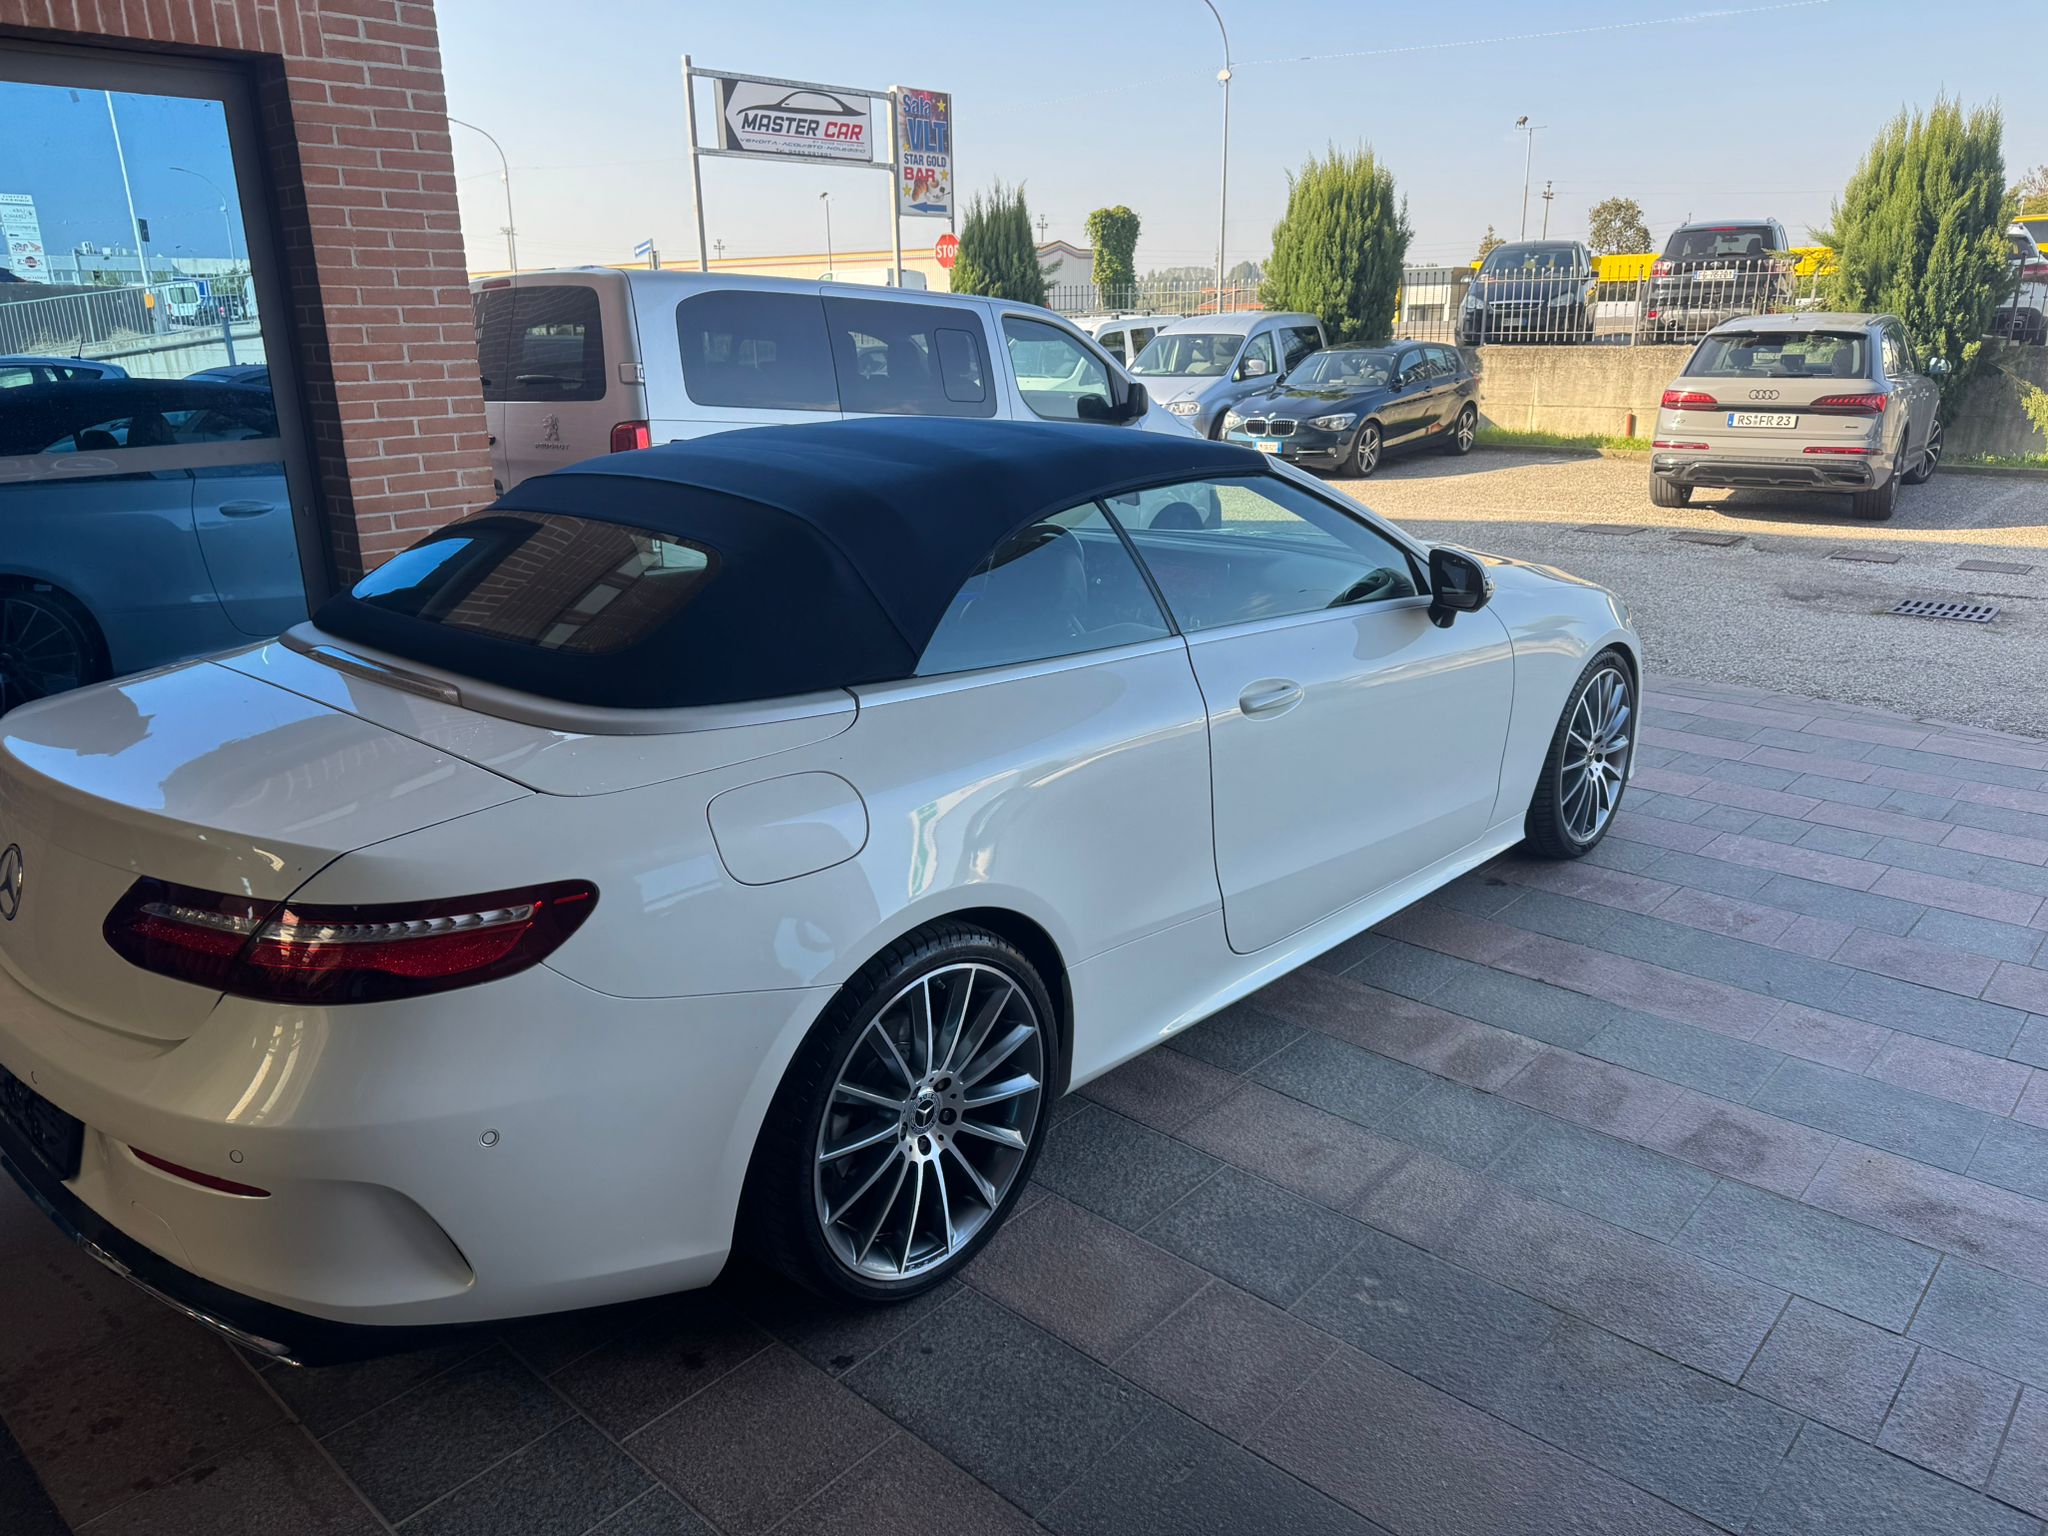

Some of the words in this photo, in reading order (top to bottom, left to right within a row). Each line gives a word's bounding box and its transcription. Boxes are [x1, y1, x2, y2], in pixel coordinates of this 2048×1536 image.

[902, 94, 931, 115] Sala
[741, 113, 820, 137] MASTER
[824, 121, 863, 140] CAR
[907, 118, 947, 152] VLT
[904, 153, 924, 166] STAR
[926, 156, 947, 168] GOLD
[904, 167, 935, 183] BAR
[1737, 415, 1753, 426] RS
[1759, 415, 1774, 427] FR
[1776, 415, 1791, 427] 23
